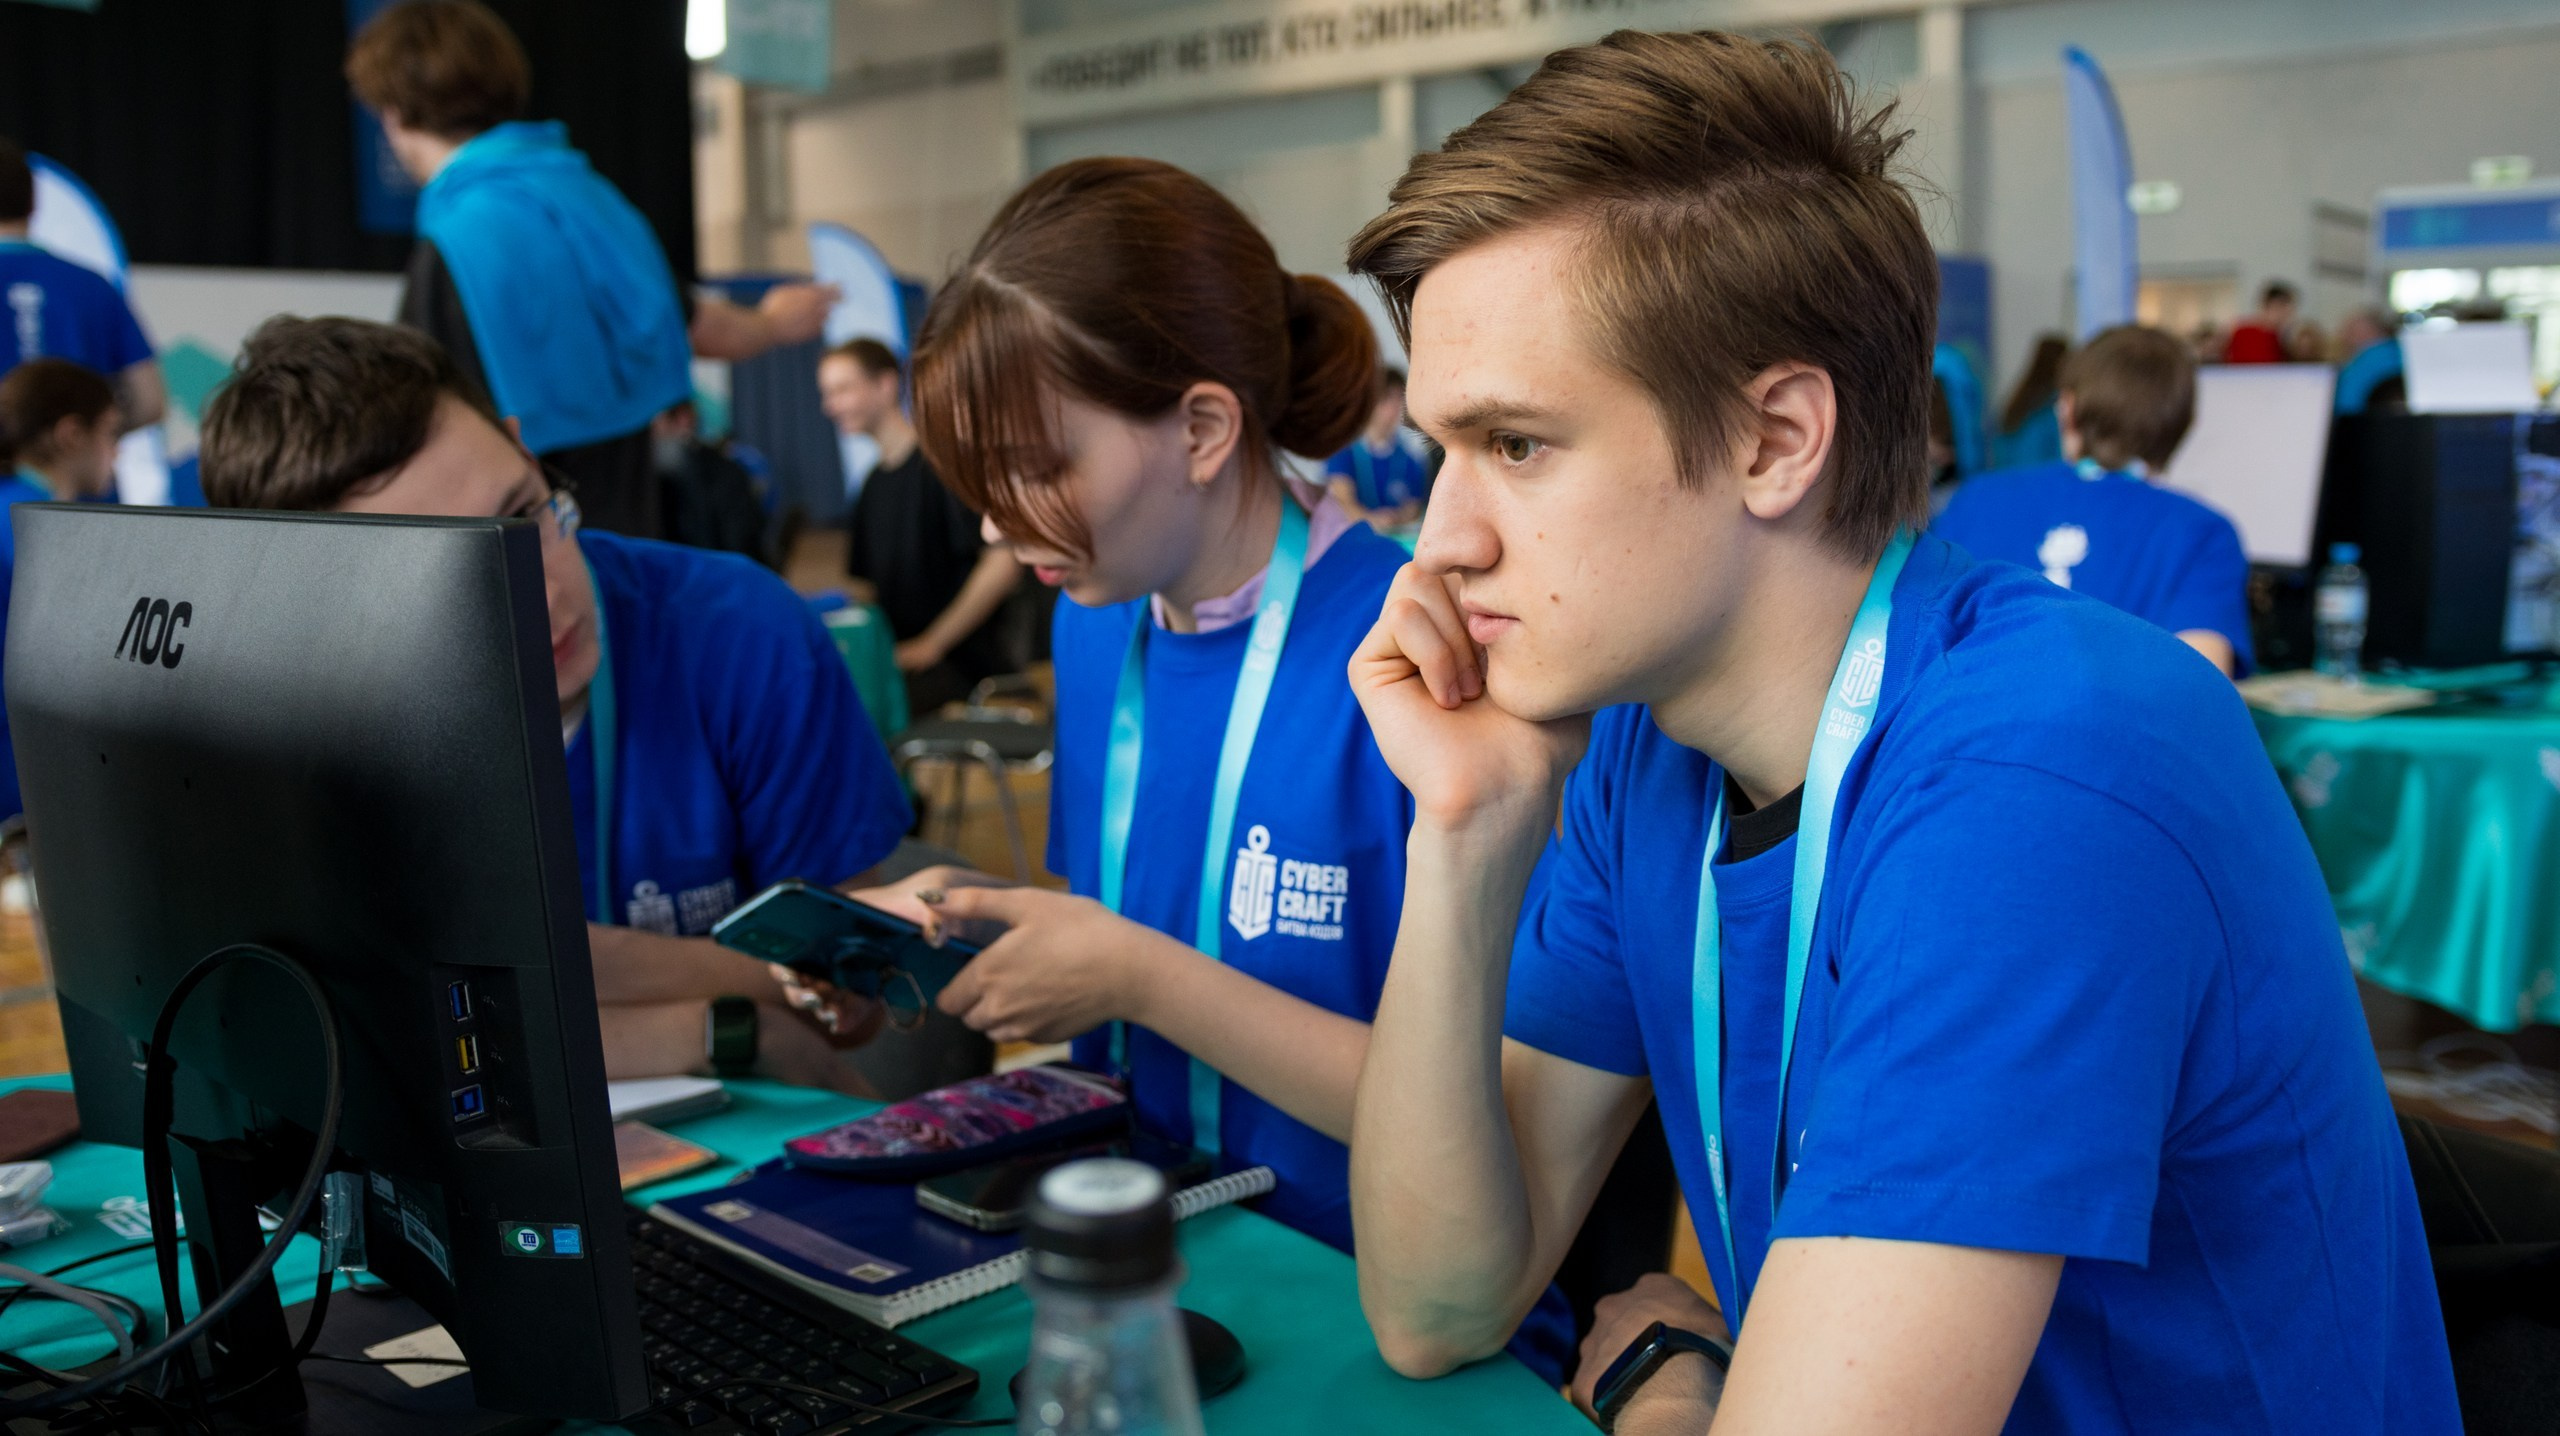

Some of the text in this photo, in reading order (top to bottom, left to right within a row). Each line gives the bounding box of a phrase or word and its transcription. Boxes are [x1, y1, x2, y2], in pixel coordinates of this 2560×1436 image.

[114, 596, 193, 669] AOC
[1825, 722, 1862, 742] CRAFT
[1830, 707, 1866, 729] CYBER
[1280, 858, 1349, 894] CYBER
[1277, 888, 1347, 924] CRAFT
[520, 1232, 536, 1244] TCO
